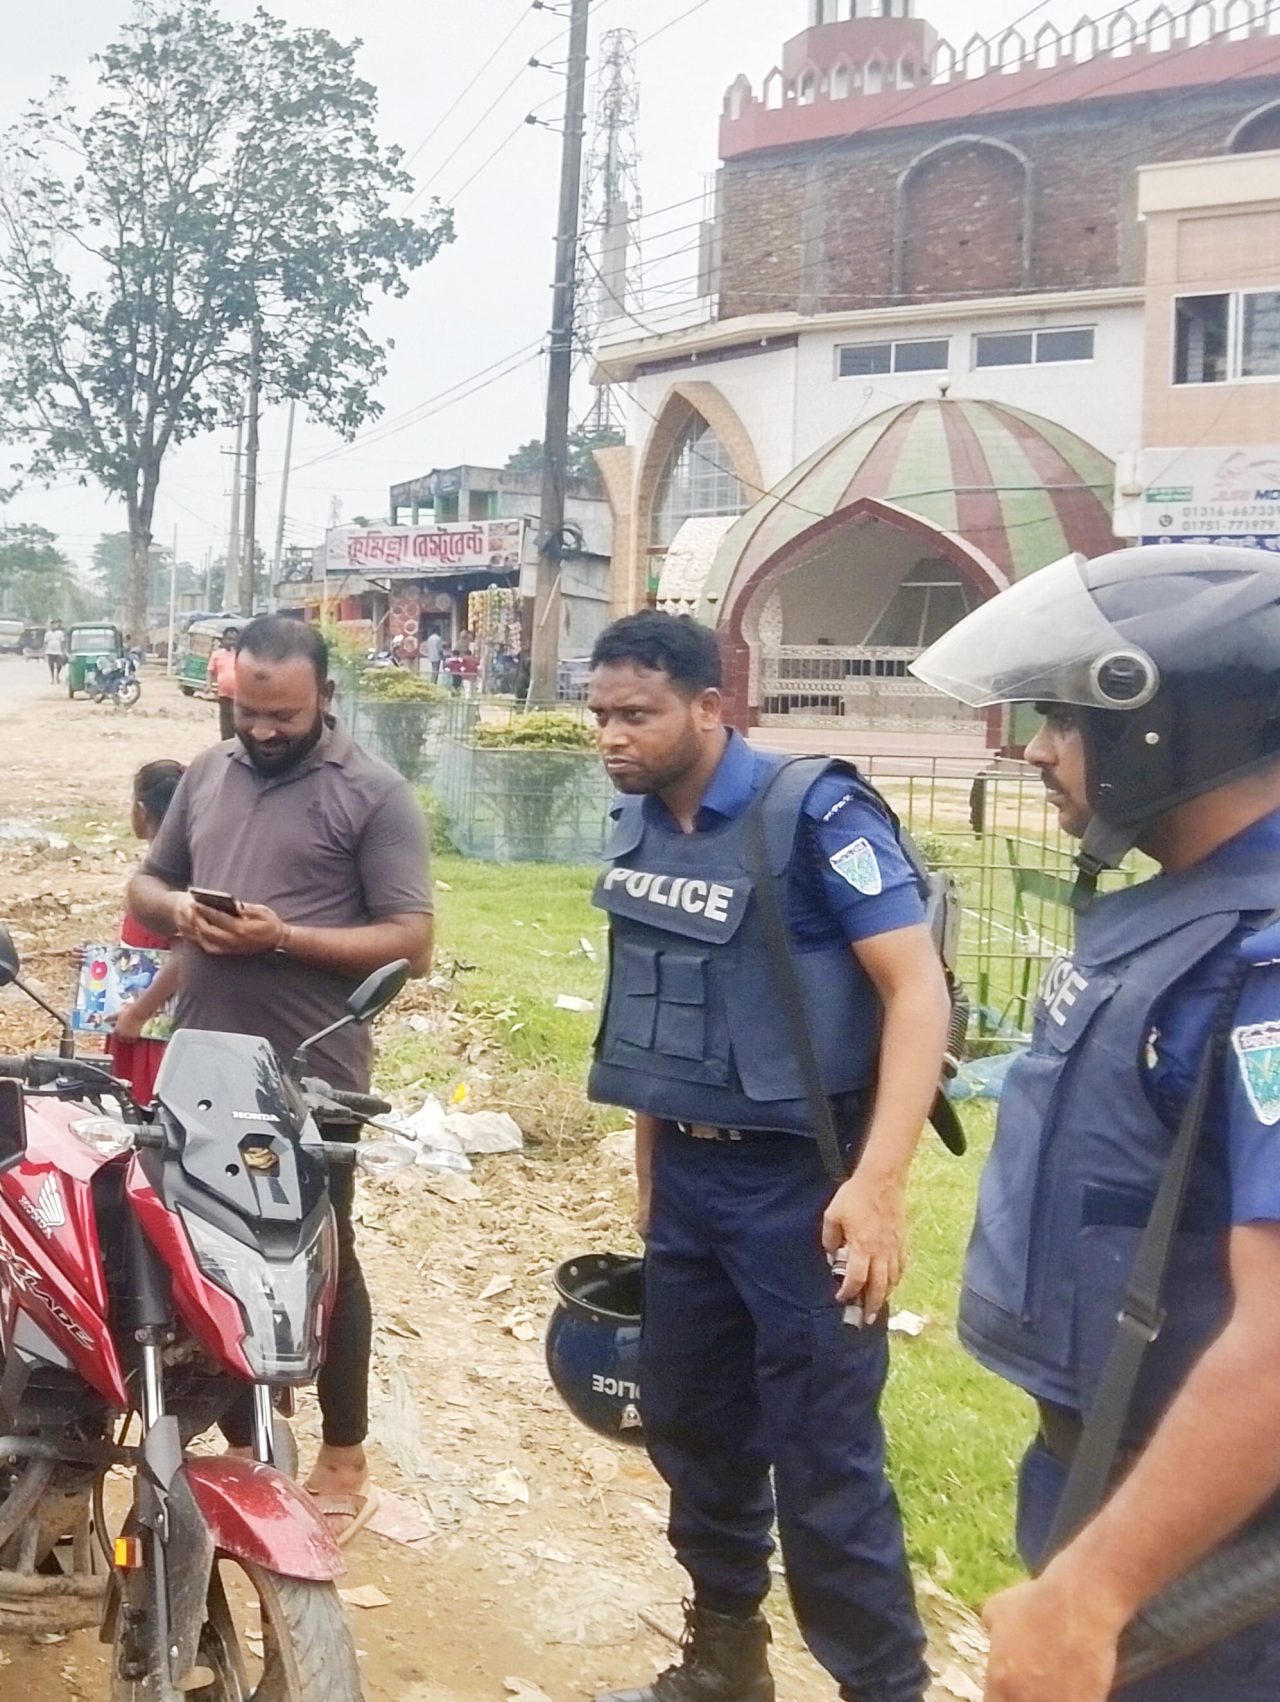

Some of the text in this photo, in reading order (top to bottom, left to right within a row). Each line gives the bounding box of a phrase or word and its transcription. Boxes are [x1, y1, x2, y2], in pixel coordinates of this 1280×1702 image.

[347, 530, 409, 566] কুমিল্লা
[603, 867, 734, 923] POLICE
[231, 1110, 281, 1123] HONDA
[18, 1194, 53, 1240] HONDA
